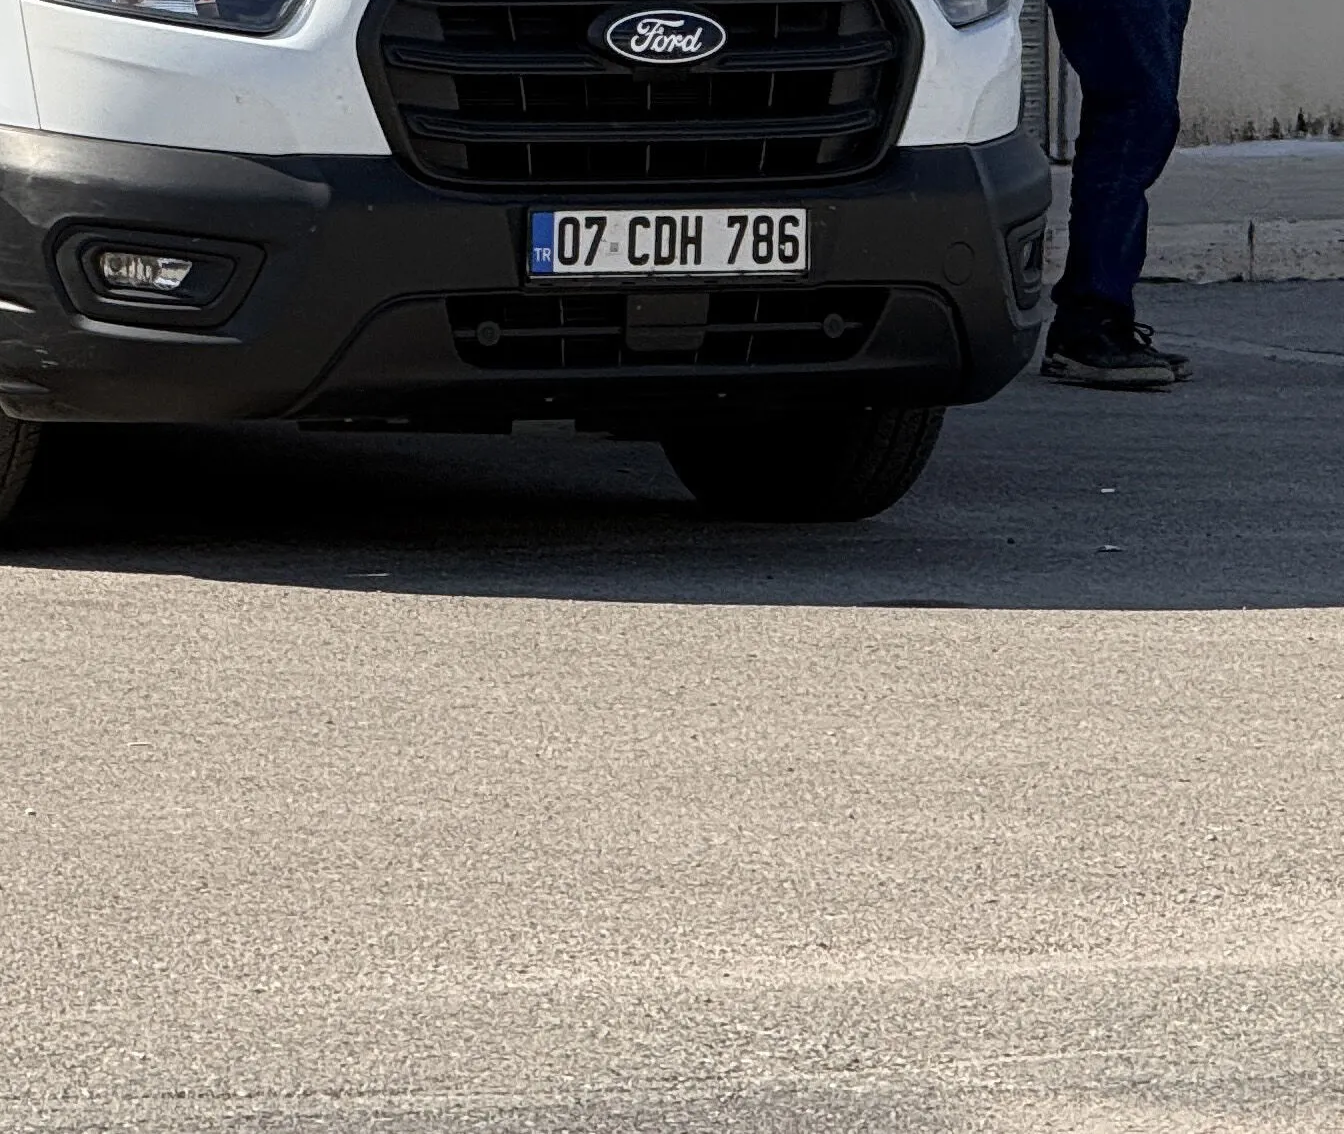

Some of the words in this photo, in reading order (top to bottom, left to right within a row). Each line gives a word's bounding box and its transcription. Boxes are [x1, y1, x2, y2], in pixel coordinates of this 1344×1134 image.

[630, 18, 703, 53] Ford
[533, 247, 551, 263] TR
[557, 216, 607, 266] 07
[627, 216, 703, 266] CDH
[726, 215, 800, 264] 786
